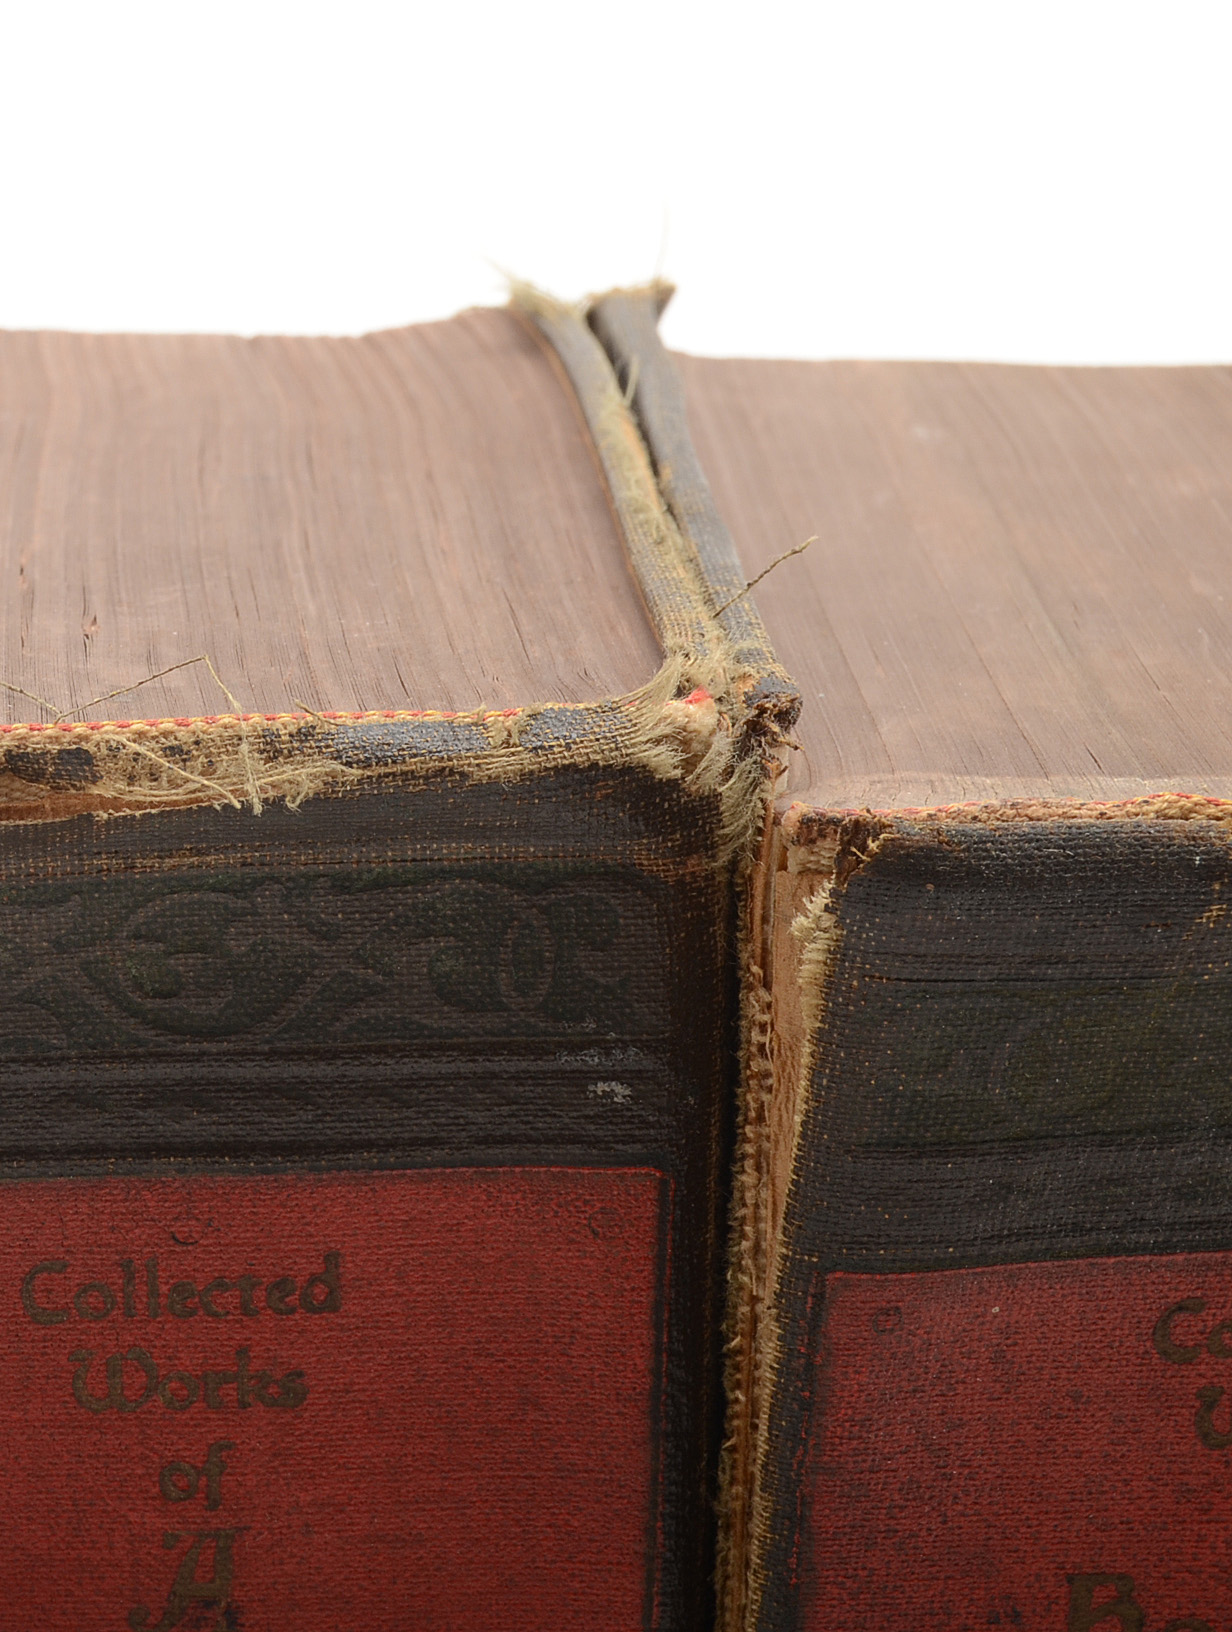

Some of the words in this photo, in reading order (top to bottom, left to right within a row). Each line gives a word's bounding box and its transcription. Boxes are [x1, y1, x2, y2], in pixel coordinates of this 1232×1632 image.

[20, 1250, 343, 1326] Collected
[69, 1347, 311, 1414] Works
[158, 1440, 236, 1512] of
